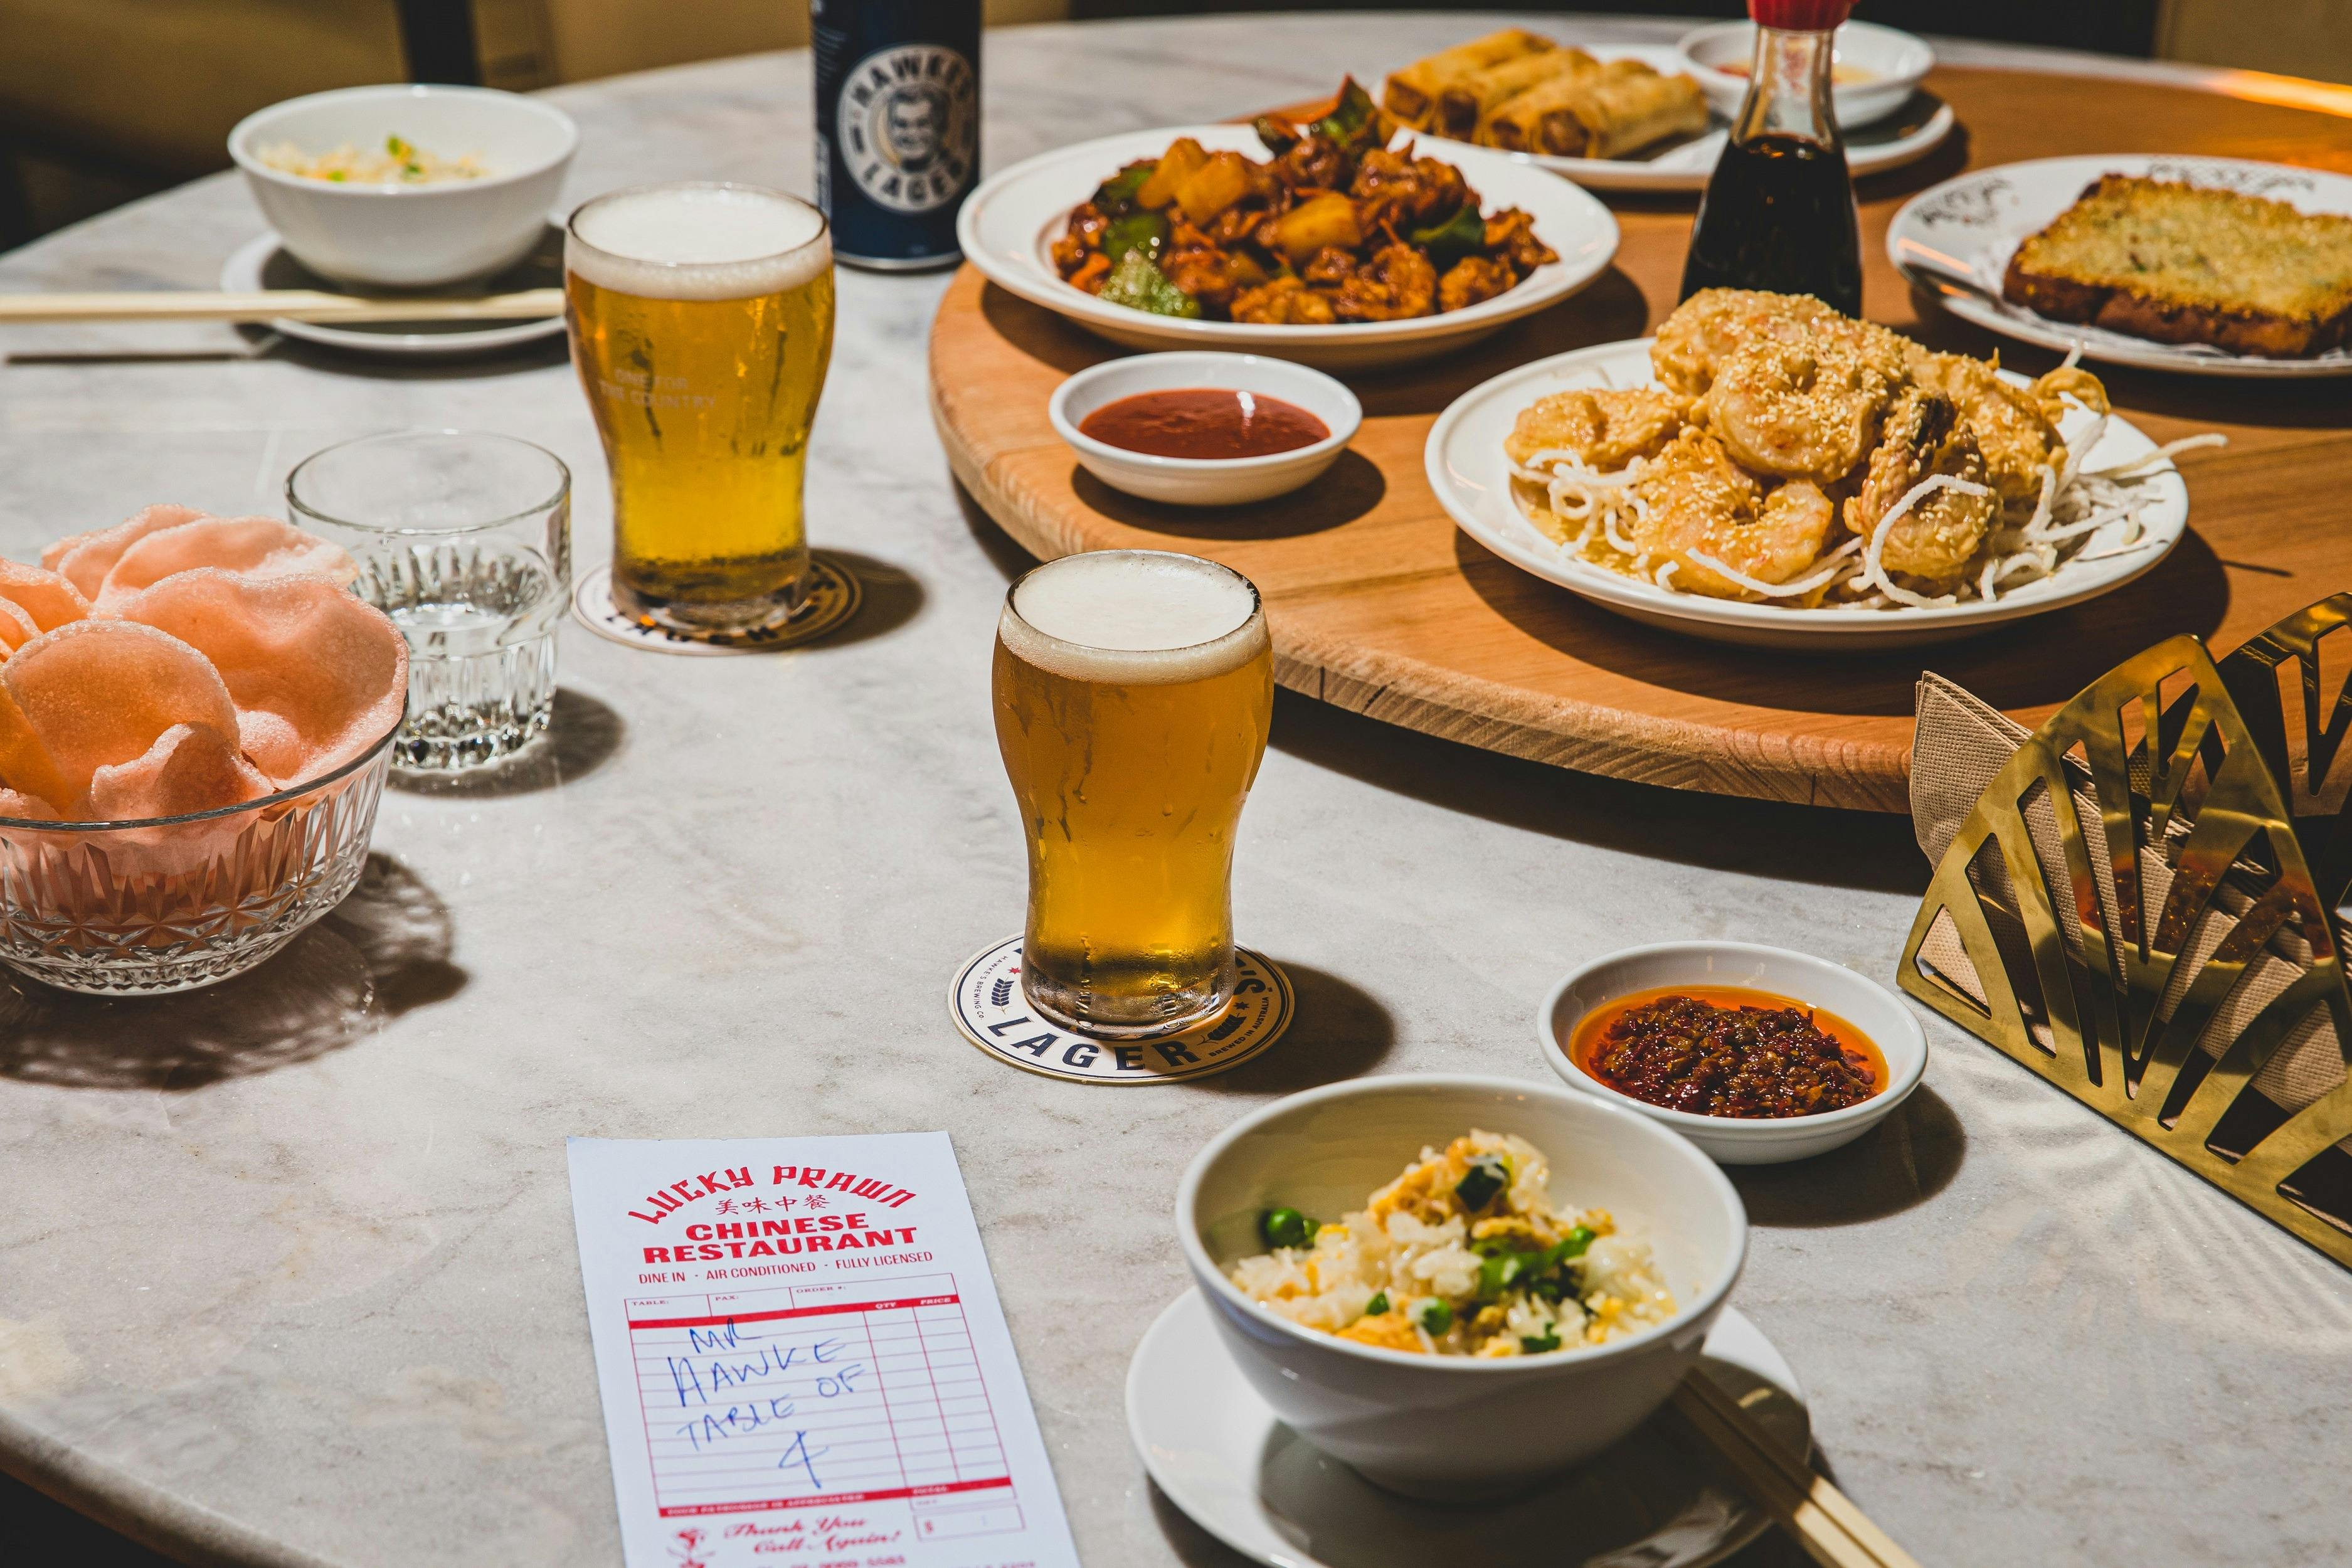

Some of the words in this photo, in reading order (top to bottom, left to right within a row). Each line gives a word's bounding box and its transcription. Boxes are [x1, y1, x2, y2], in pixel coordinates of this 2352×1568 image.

[980, 955, 1009, 980] HAWKE'S
[973, 981, 984, 1010] BREWING
[987, 1015, 1202, 1071] LAGER
[1208, 1036, 1246, 1057] BREWED
[1244, 1029, 1254, 1037] IN
[1253, 997, 1270, 1030] AUSTRALIA
[628, 1165, 754, 1225] LUCKY
[773, 1165, 916, 1209] PRAWN
[716, 1194, 831, 1216] 美味中餐
[685, 1213, 869, 1241] CHINESE
[643, 1227, 918, 1264] RESTAURANT
[638, 1273, 669, 1284] DINE
[672, 1271, 686, 1283] IN
[706, 1269, 728, 1280] AIR
[730, 1261, 816, 1278] CONDITIONED
[835, 1256, 869, 1269] FULLY
[874, 1251, 933, 1267] LICENSED
[875, 1301, 897, 1310] QTY
[919, 1297, 951, 1305] PRICE
[667, 1337, 846, 1407] HAWKE
[676, 1394, 795, 1452] TABLE
[816, 1363, 866, 1398] OF
[778, 1430, 830, 1490] 4
[724, 1519, 803, 1539] Thank
[812, 1515, 866, 1536] You
[754, 1537, 805, 1554] Call
[807, 1529, 901, 1553] Again!
